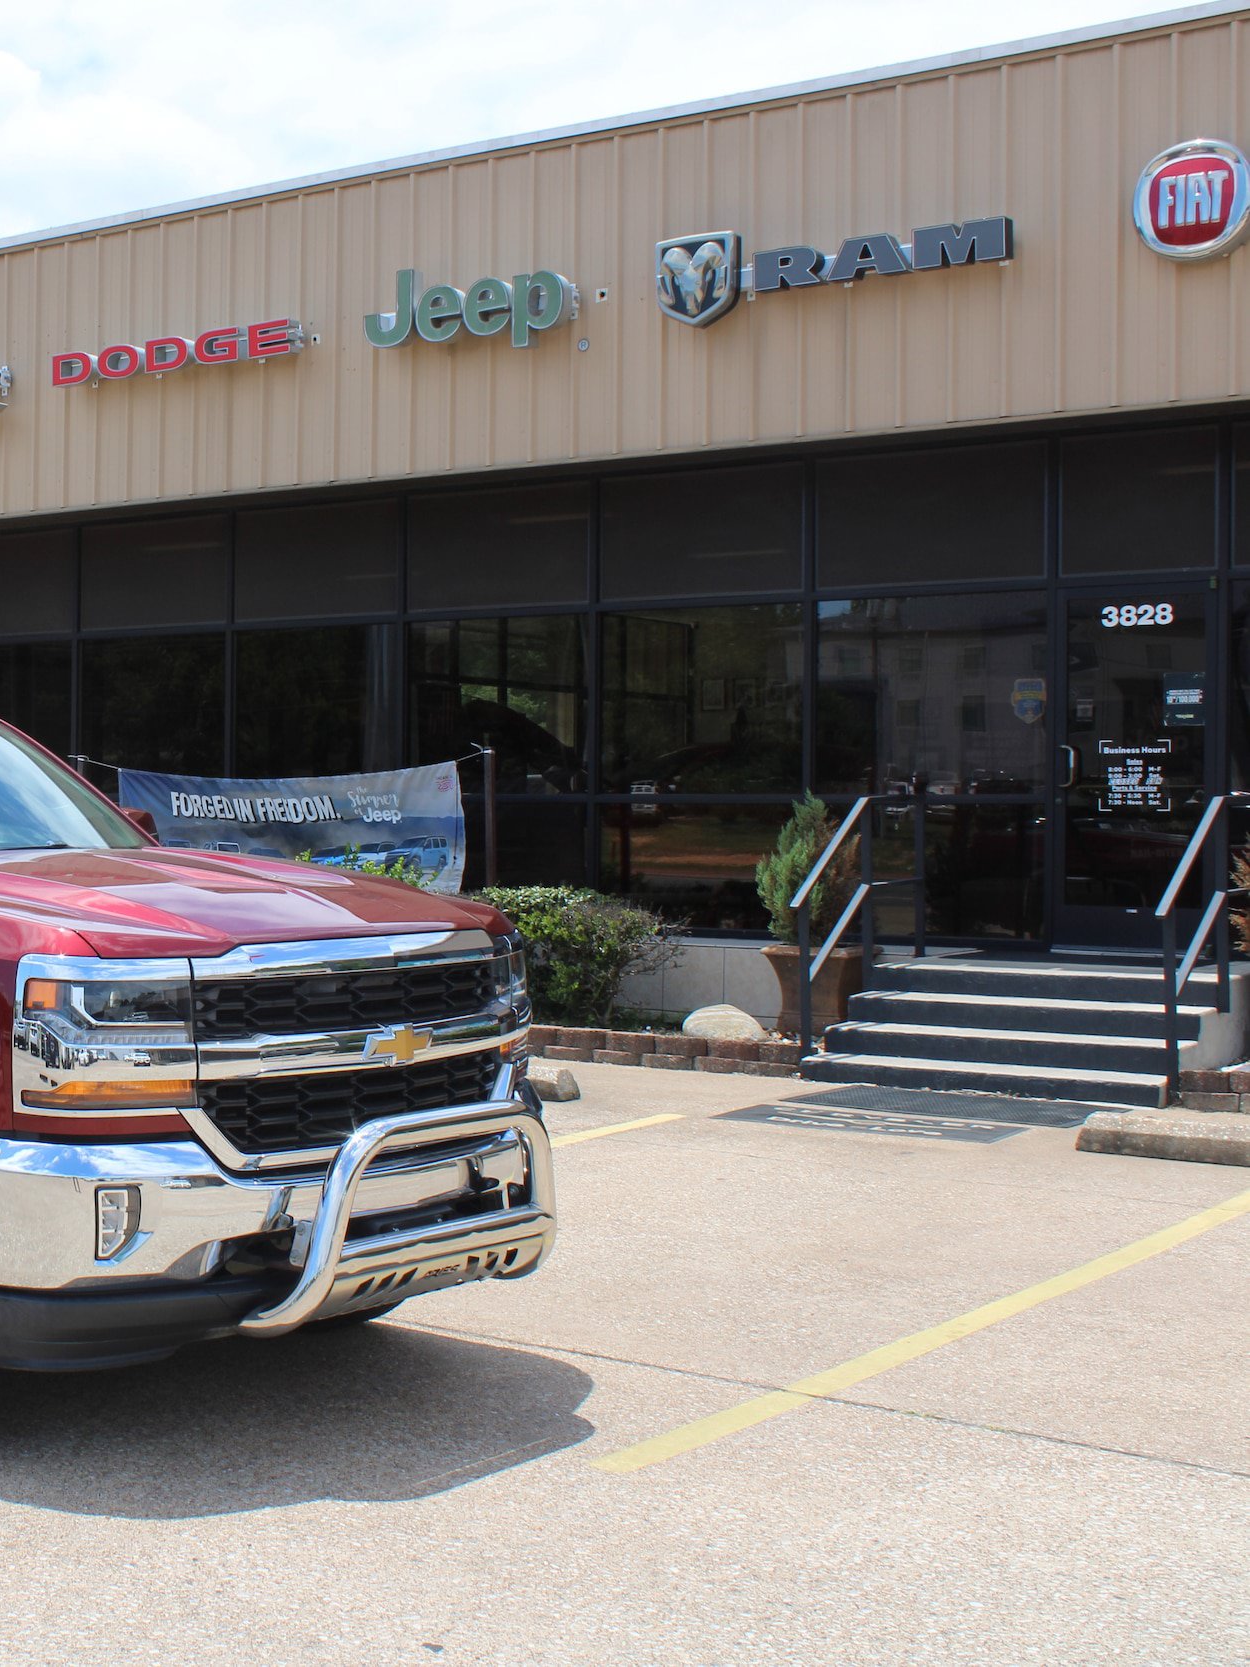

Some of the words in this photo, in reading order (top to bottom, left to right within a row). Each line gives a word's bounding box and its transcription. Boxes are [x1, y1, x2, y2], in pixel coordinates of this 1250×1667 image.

[1158, 169, 1230, 229] FIAT
[753, 216, 1013, 292] RAM
[364, 268, 570, 349] Jeep
[52, 318, 298, 388] DODGE
[1101, 603, 1173, 628] 3828
[1103, 746, 1140, 754] Business
[1141, 746, 1166, 754] Hours
[170, 791, 237, 820] FORGED
[233, 798, 257, 823] IN
[363, 806, 402, 824] Jeep
